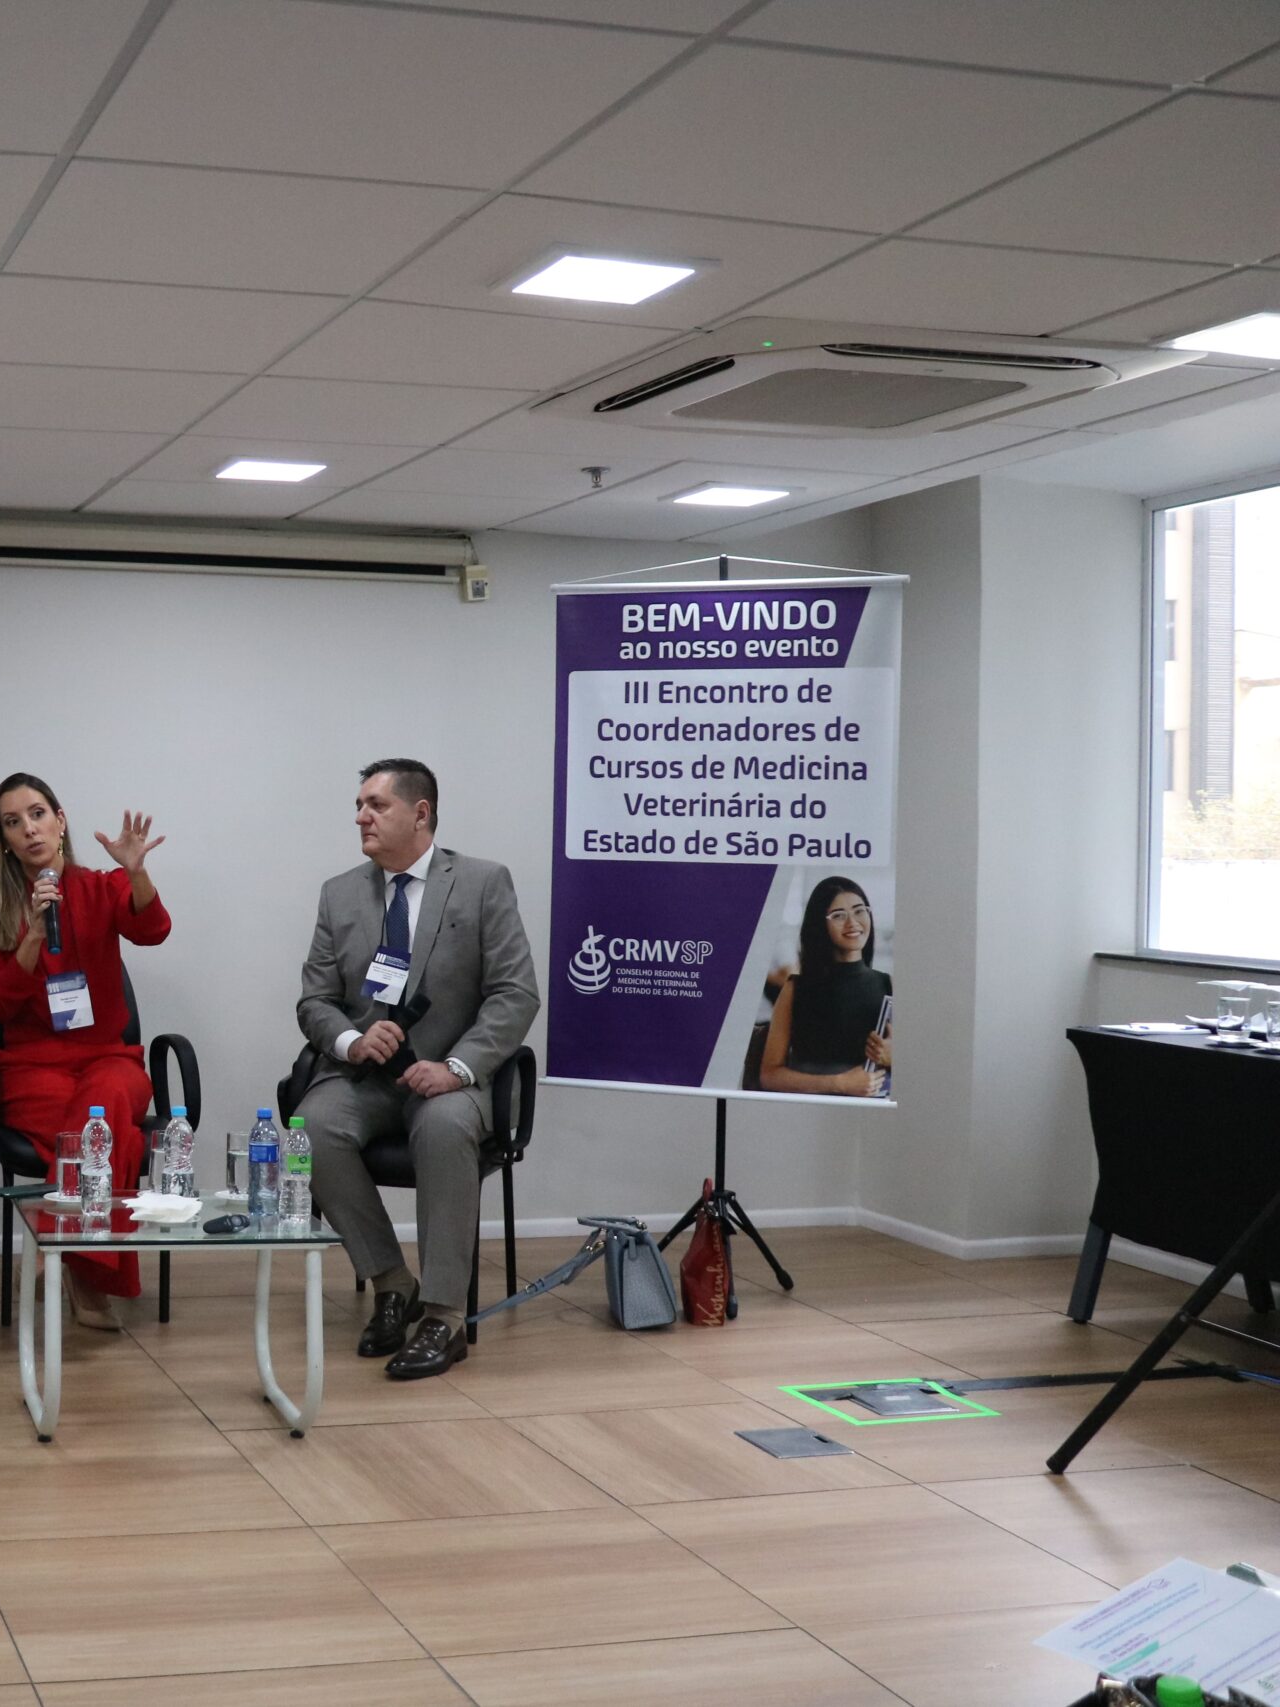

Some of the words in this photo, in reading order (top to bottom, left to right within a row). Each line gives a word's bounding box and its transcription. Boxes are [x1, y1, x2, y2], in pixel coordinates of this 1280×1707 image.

[622, 599, 837, 633] BEM-VINDO
[620, 641, 651, 660] ao
[658, 639, 737, 659] nosso
[745, 636, 839, 658] evento
[624, 681, 648, 704] III
[658, 681, 788, 704] Encontro
[798, 678, 832, 703] de
[597, 717, 816, 741] Coordenadores
[825, 716, 860, 742] de
[589, 755, 683, 779] Cursos
[692, 755, 725, 779] de
[734, 755, 867, 780] Medicina
[624, 792, 780, 818] Veterinária
[790, 793, 826, 819] do
[583, 829, 675, 854] Estado
[684, 830, 718, 855] de
[726, 831, 779, 856] São
[788, 833, 871, 859] Paulo
[608, 938, 713, 966] CRMVSP
[615, 968, 653, 977] CONSELHO
[653, 969, 689, 979] REGIONAL
[617, 978, 652, 986] MEDICINA
[653, 977, 698, 989] VETERINÁRIA
[624, 987, 651, 995] ESTADO
[652, 988, 662, 996] DE
[663, 988, 679, 997] SÃO
[679, 990, 703, 998] PAULO
